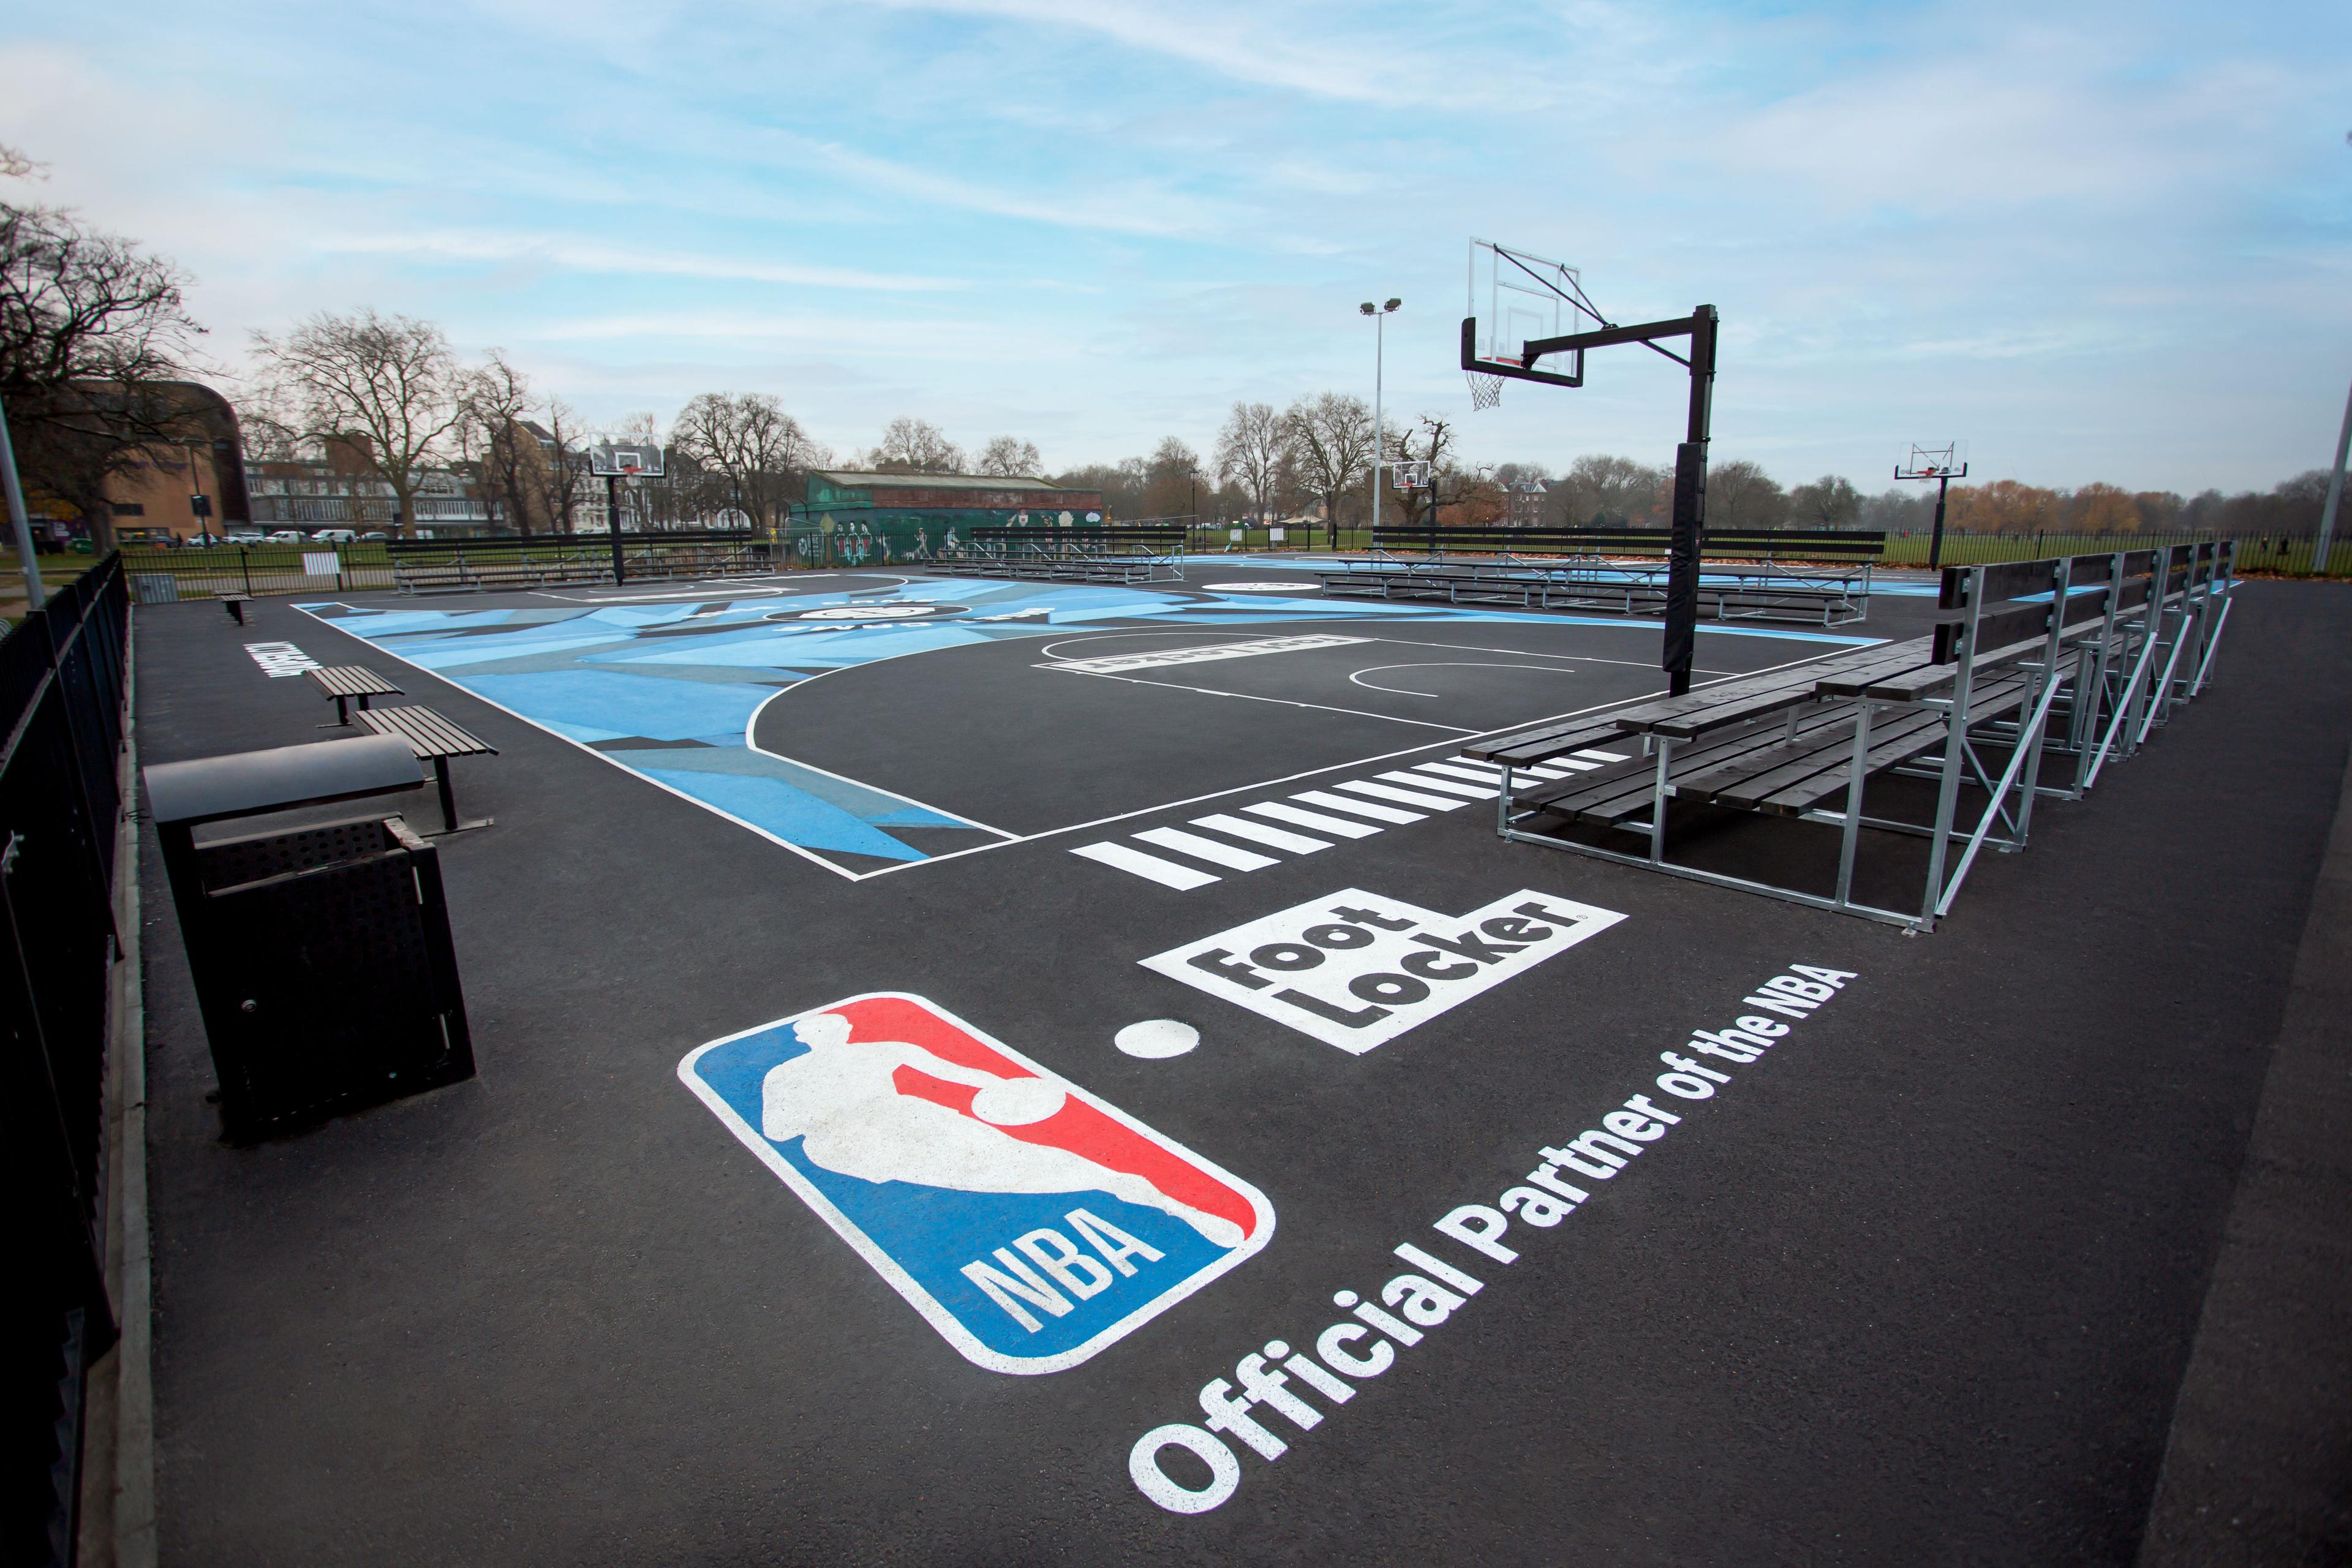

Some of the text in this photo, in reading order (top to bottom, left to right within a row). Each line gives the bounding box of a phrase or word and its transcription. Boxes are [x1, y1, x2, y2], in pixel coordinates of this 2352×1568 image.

[1085, 647, 1254, 668] Locker
[1187, 907, 1418, 990] Foot
[1272, 902, 1579, 1028] Locker
[960, 1208, 1166, 1333] NBA
[1129, 963, 1858, 1513] Official Partner of the NBA
